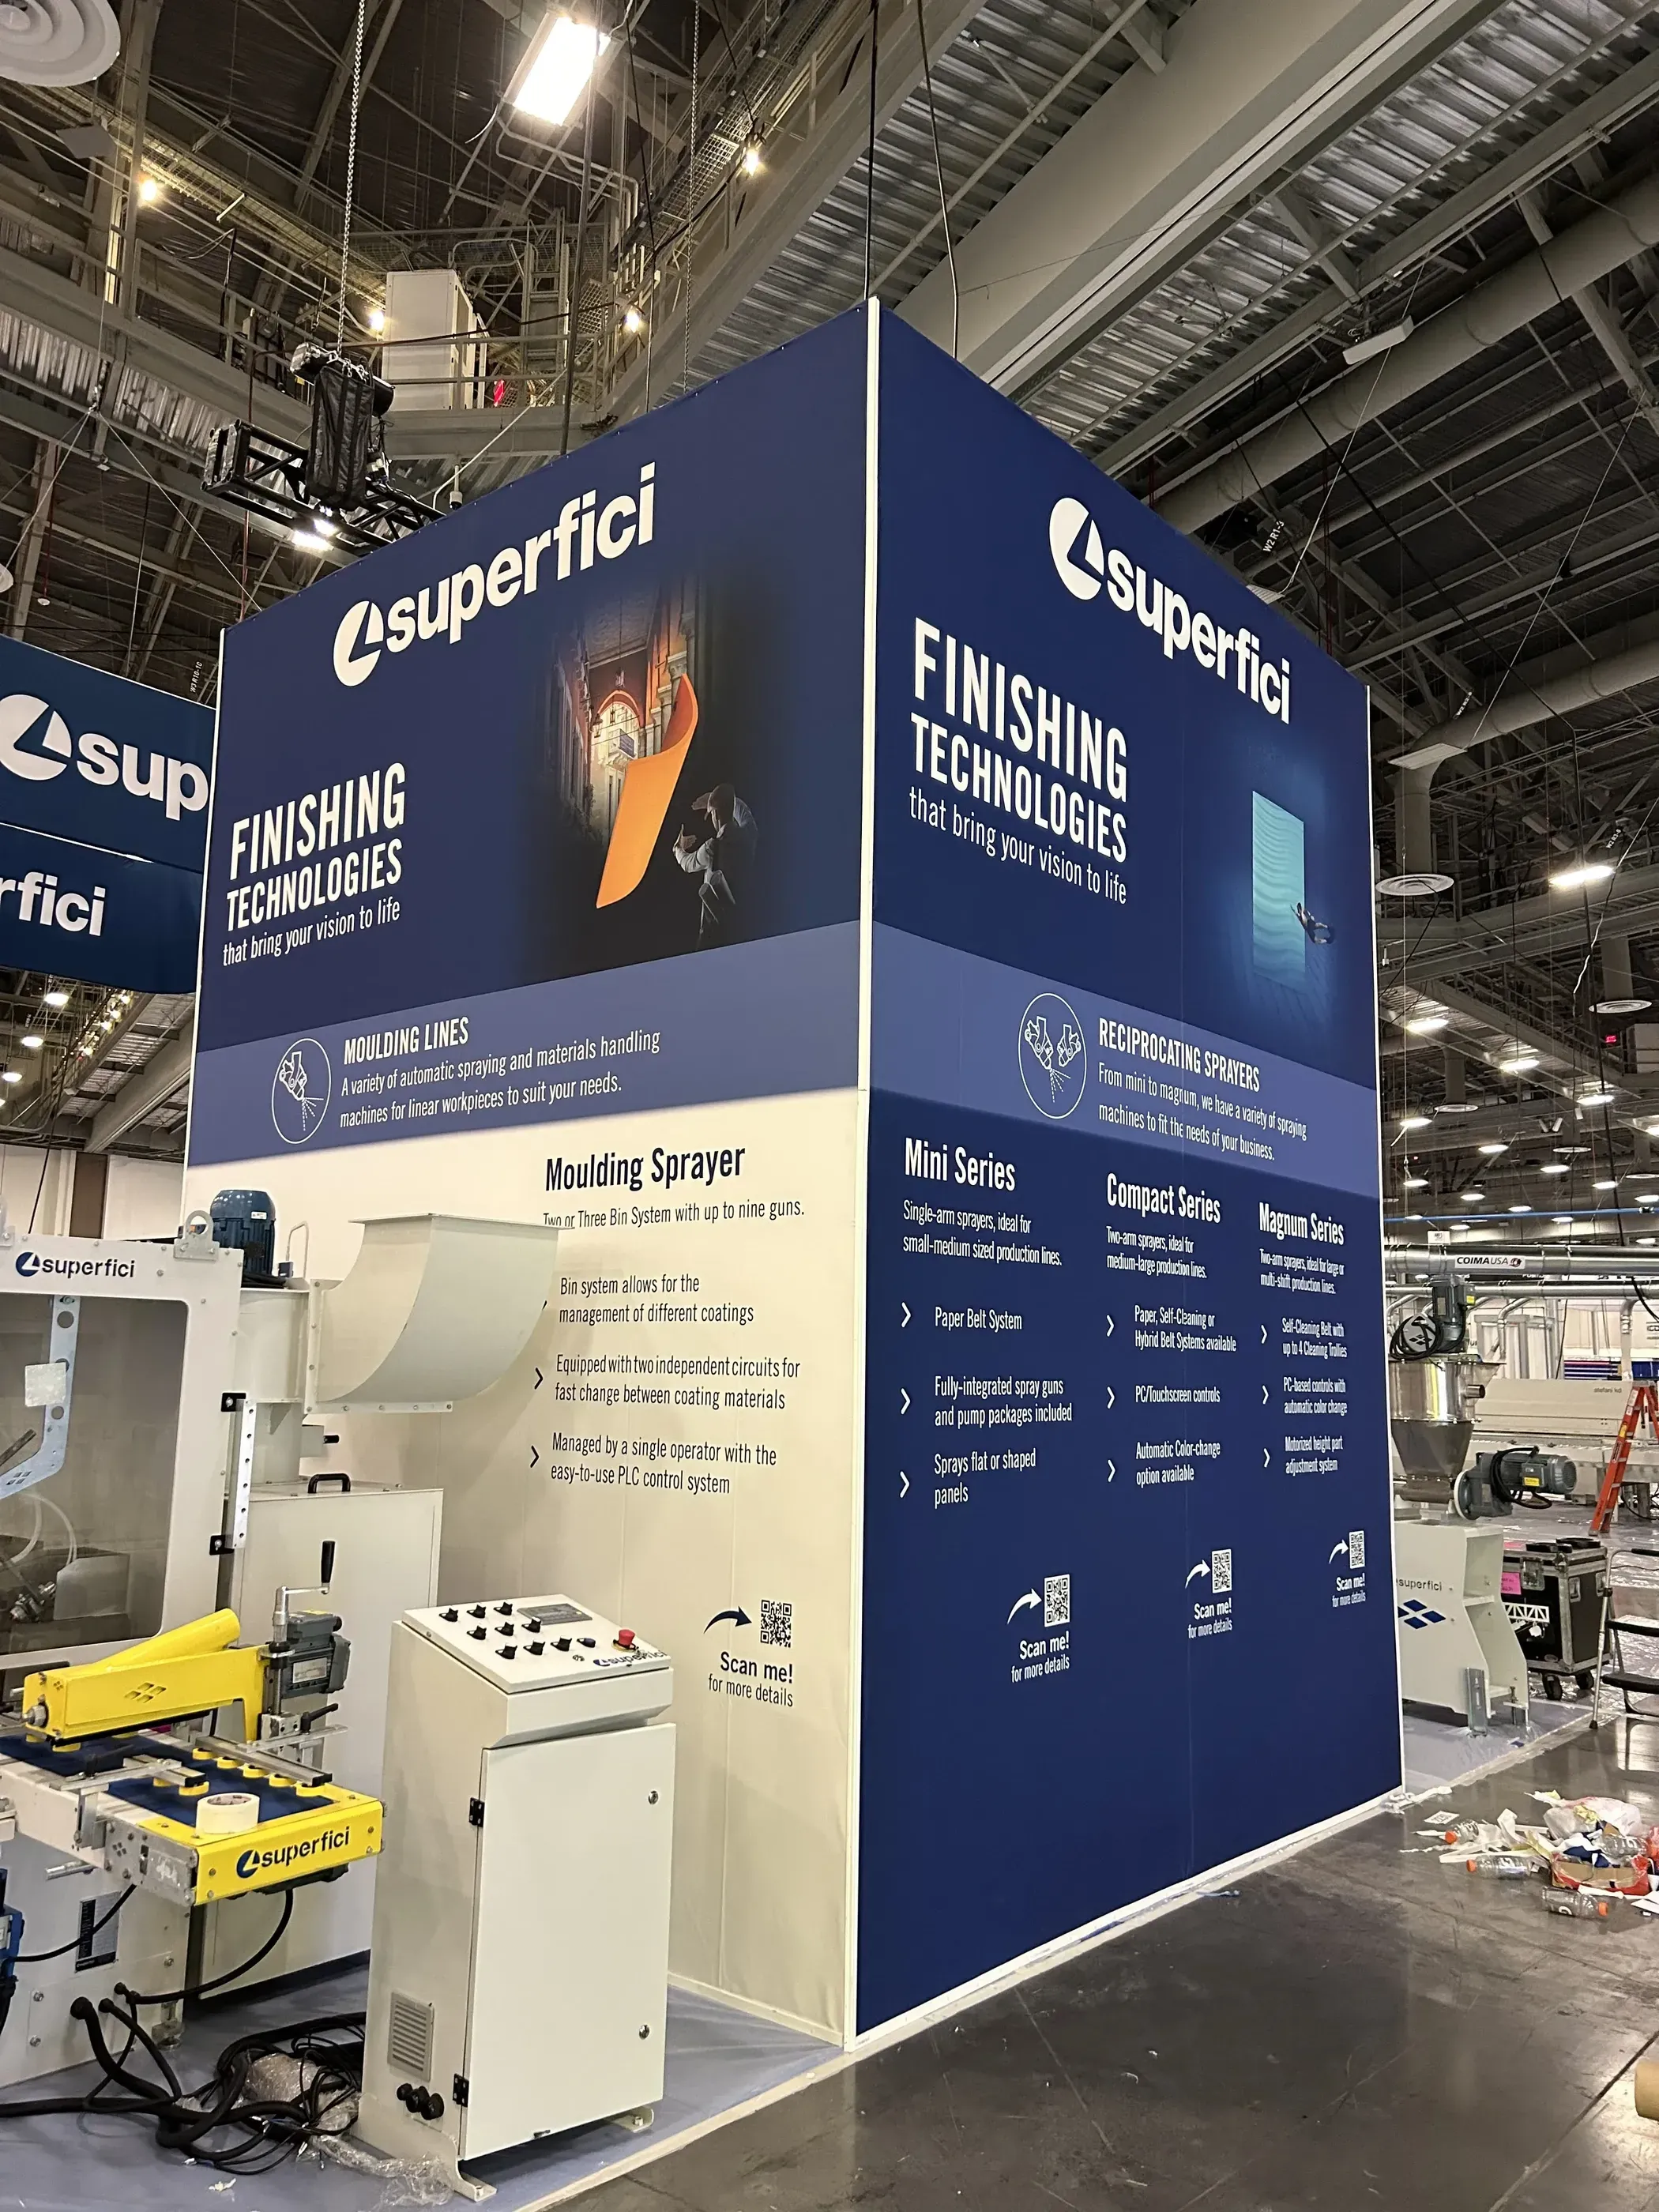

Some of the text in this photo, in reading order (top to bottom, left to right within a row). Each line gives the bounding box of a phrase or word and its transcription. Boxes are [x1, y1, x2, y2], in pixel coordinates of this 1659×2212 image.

[386, 461, 655, 653] superfici
[1262, 540, 1275, 551] W2
[1107, 549, 1290, 724] superfici
[915, 617, 1127, 803] FINISHING
[911, 712, 1127, 863] TECHNOLOGIES
[229, 762, 406, 880] FINISHING
[909, 786, 1127, 905] that bring your vision to life
[227, 838, 403, 931] TECHNOLOGIES
[223, 897, 400, 966] that bring your vision to life
[344, 1017, 468, 1065] MOULDING LINES
[1098, 1018, 1259, 1092] RECIPROCATING SPRAYERS
[341, 1030, 660, 1096] A variety of automatic spraying and materials handling
[340, 1073, 622, 1127] machines for linear workpieces to suit your needs.
[1099, 1062, 1307, 1141] From mini to magnum, we have a variety of spraying
[1099, 1104, 1275, 1161] machines to fit the needs of your business.
[546, 1147, 745, 1191] Moulding Sprayer
[905, 1138, 1015, 1191] Mini Series
[565, 1215, 575, 1227] or
[577, 1210, 606, 1228] Three
[610, 1208, 627, 1225] Bin
[631, 1206, 671, 1228] System
[675, 1202, 699, 1221] with
[705, 1206, 718, 1223] up
[723, 1202, 734, 1219] to
[739, 1199, 765, 1218] nine
[769, 1199, 804, 1221] guns.
[1107, 1172, 1221, 1224] Compact Series
[904, 1199, 1031, 1233] Single-arm sprayers, ideal for
[1258, 1202, 1344, 1246] Magnum Series
[42, 1258, 135, 1278] superfici
[560, 1273, 699, 1298] Bin system allows for the
[559, 1303, 754, 1326] management of different coatings
[935, 1307, 1022, 1333] Paper Belt System
[556, 1354, 800, 1379] Equipped with two independent circuits for
[555, 1382, 785, 1410] fast change between coating materials
[935, 1375, 1063, 1400] Fully-integrated spray guns
[1136, 1385, 1220, 1402] PC/Touchscreen controls
[935, 1402, 1072, 1429] and pump packages included
[552, 1432, 777, 1466] Managed by a single operator with the
[935, 1448, 1036, 1477] Sprays flat or shaped
[551, 1465, 730, 1495] easy-to-use PLC control system
[1398, 1579, 1442, 1591] superfici
[1194, 1598, 1232, 1620] Scan me!
[1019, 1631, 1070, 1660] Scan me!
[720, 1651, 793, 1683] Scan me!
[1011, 1654, 1070, 1683] for more details
[709, 1673, 793, 1706] for more details
[261, 1826, 350, 1868] superfici
